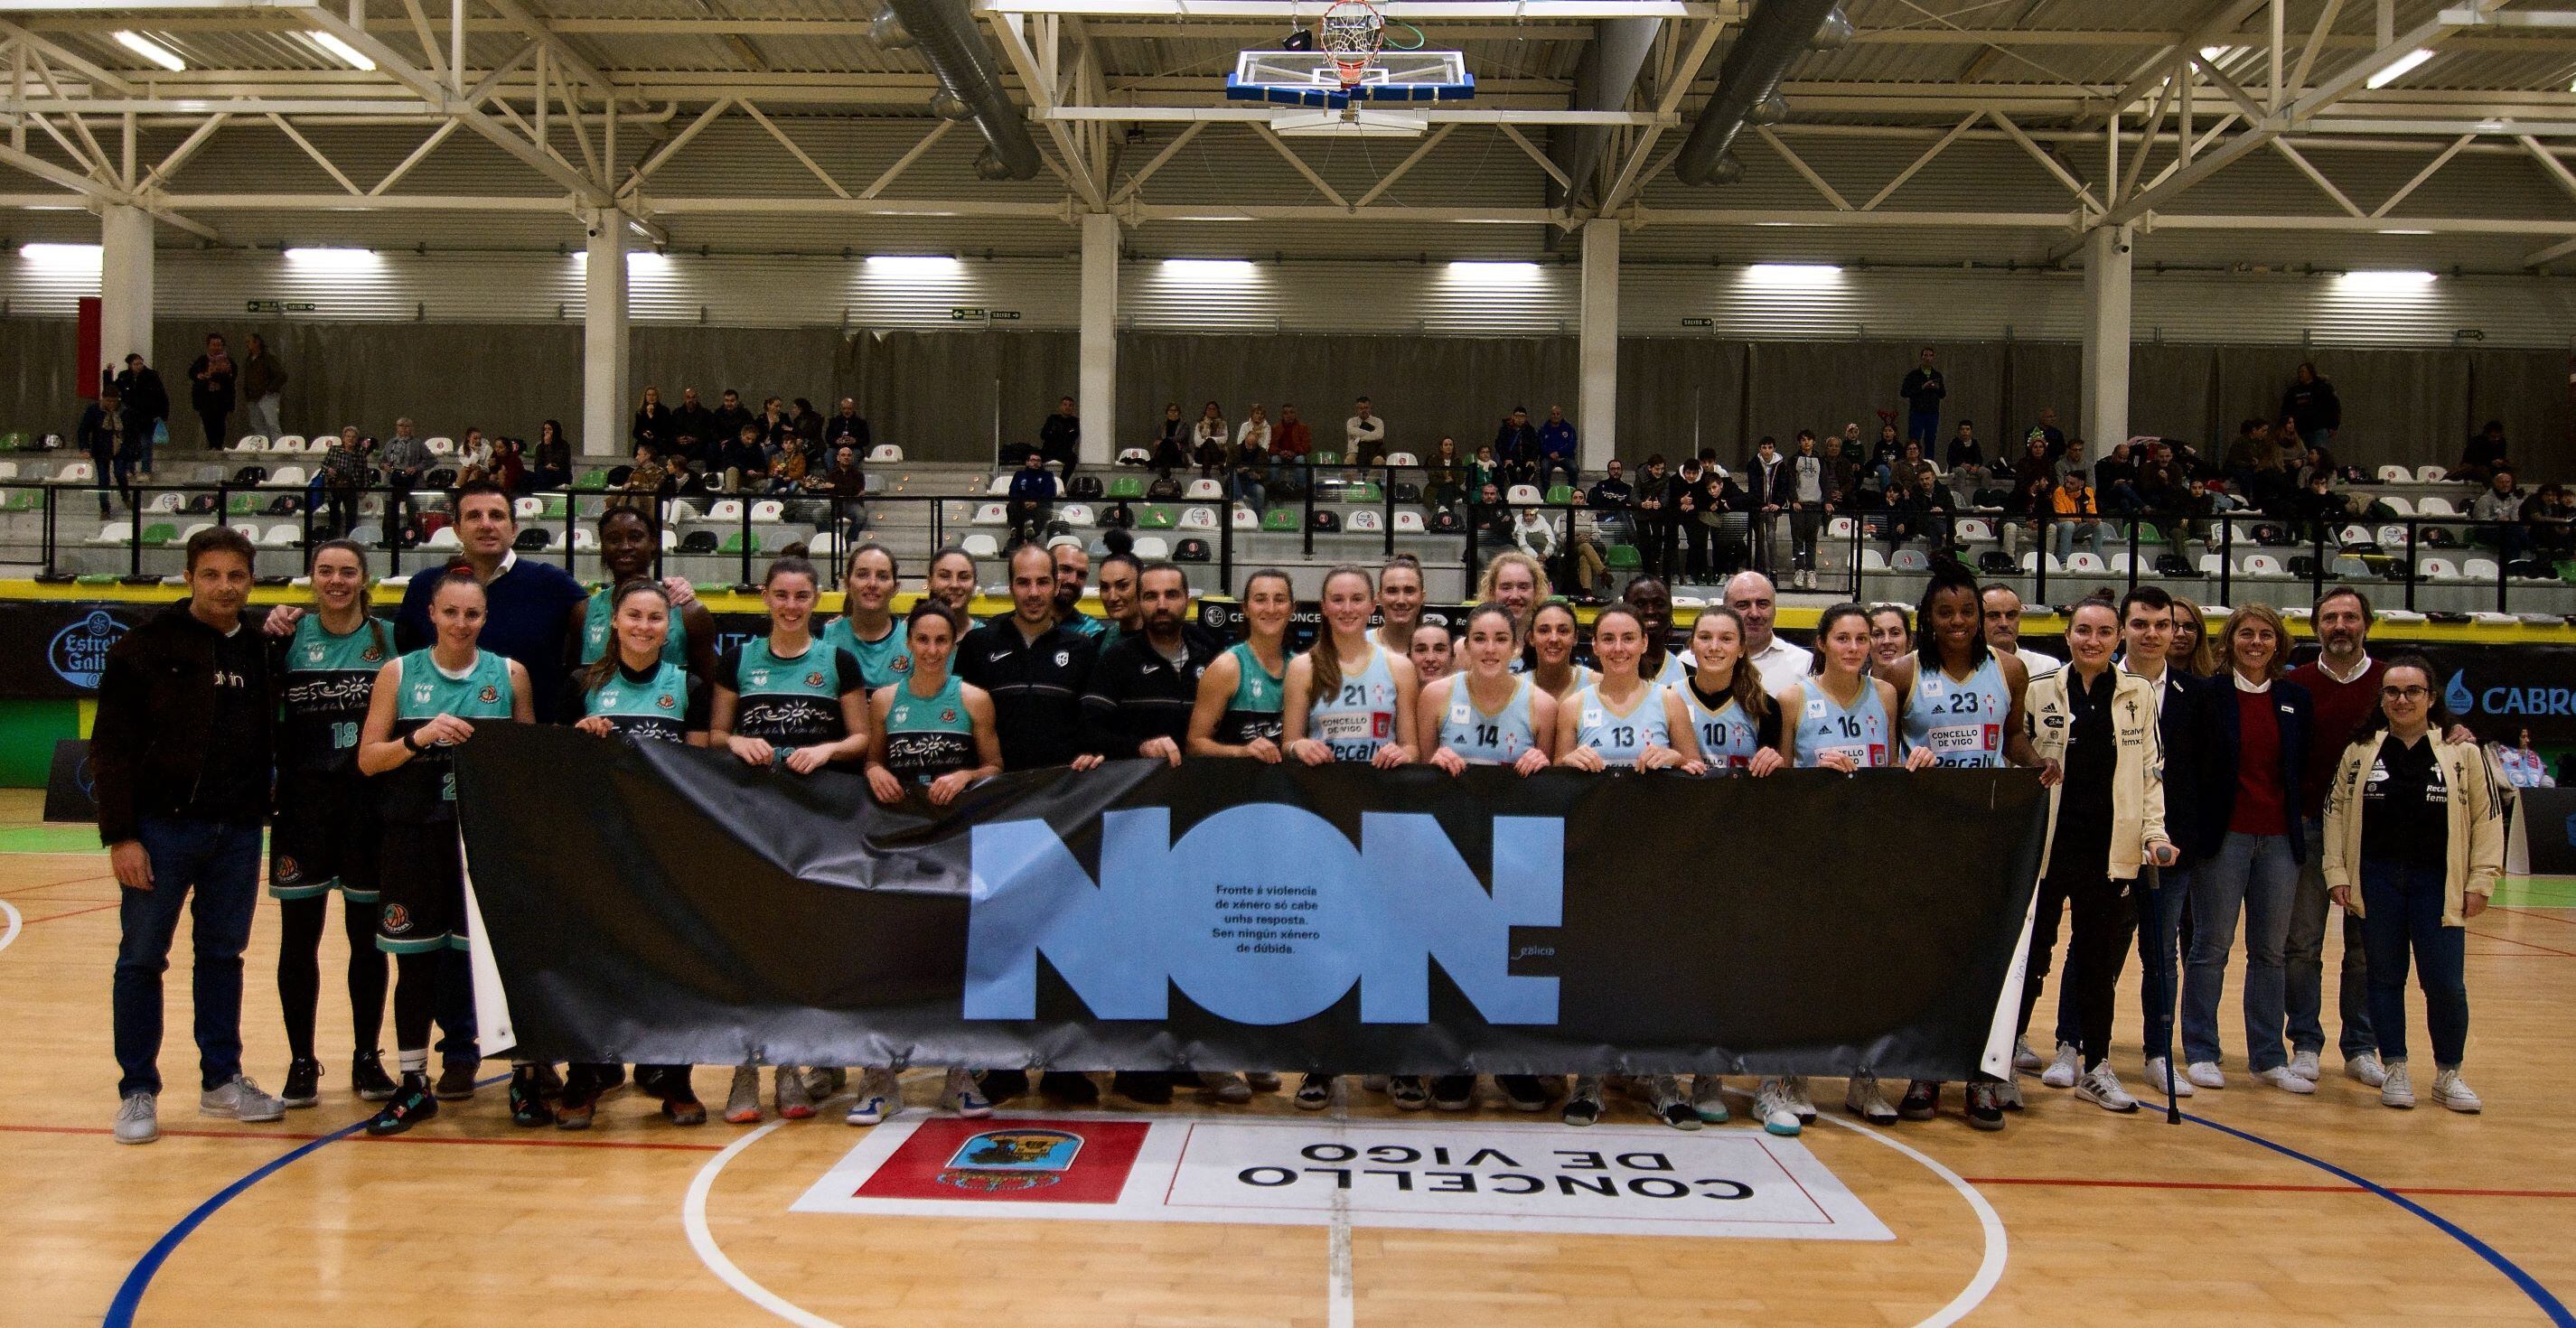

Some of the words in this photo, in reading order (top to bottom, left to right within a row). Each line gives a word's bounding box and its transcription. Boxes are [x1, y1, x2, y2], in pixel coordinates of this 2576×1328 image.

[1230, 613, 1244, 622] CE
[1288, 613, 1322, 623] ONCE
[1456, 618, 1466, 626] Re
[69, 653, 106, 670] Gali
[1344, 685, 1367, 706] 21
[1950, 692, 1979, 714] 23
[2482, 687, 2576, 715] CABR
[1323, 717, 1367, 726] CONCELLO
[1327, 726, 1340, 734] DE
[1342, 725, 1363, 734] VIGO
[1838, 715, 1861, 738] 16
[332, 722, 359, 749] 18
[1476, 724, 1499, 748] 14
[1611, 726, 1635, 748] 13
[1702, 723, 1726, 746] 10
[1932, 730, 1978, 740] CONCELLO
[1952, 738, 1973, 746] VIGO
[1325, 740, 1380, 762] ecal
[2427, 784, 2447, 792] Reca
[1215, 884, 1254, 895] Fronte
[1266, 885, 1317, 896] violencia
[1215, 900, 1229, 910] de
[1232, 900, 1271, 910] xénero
[1274, 900, 1288, 910] só
[1291, 900, 1318, 911] cabe
[1224, 914, 1253, 924] unha
[1256, 914, 1308, 926] resposta.
[1212, 928, 1234, 938] Sen
[1238, 928, 1277, 940] ningún
[1280, 929, 1320, 940] xénero
[1236, 943, 1251, 953] de
[1254, 943, 1296, 954] dúbida.
[1300, 1143, 1522, 1167] VIGO
[1553, 1149, 1675, 1171] DE
[1238, 1165, 1755, 1200] CONCELLO
